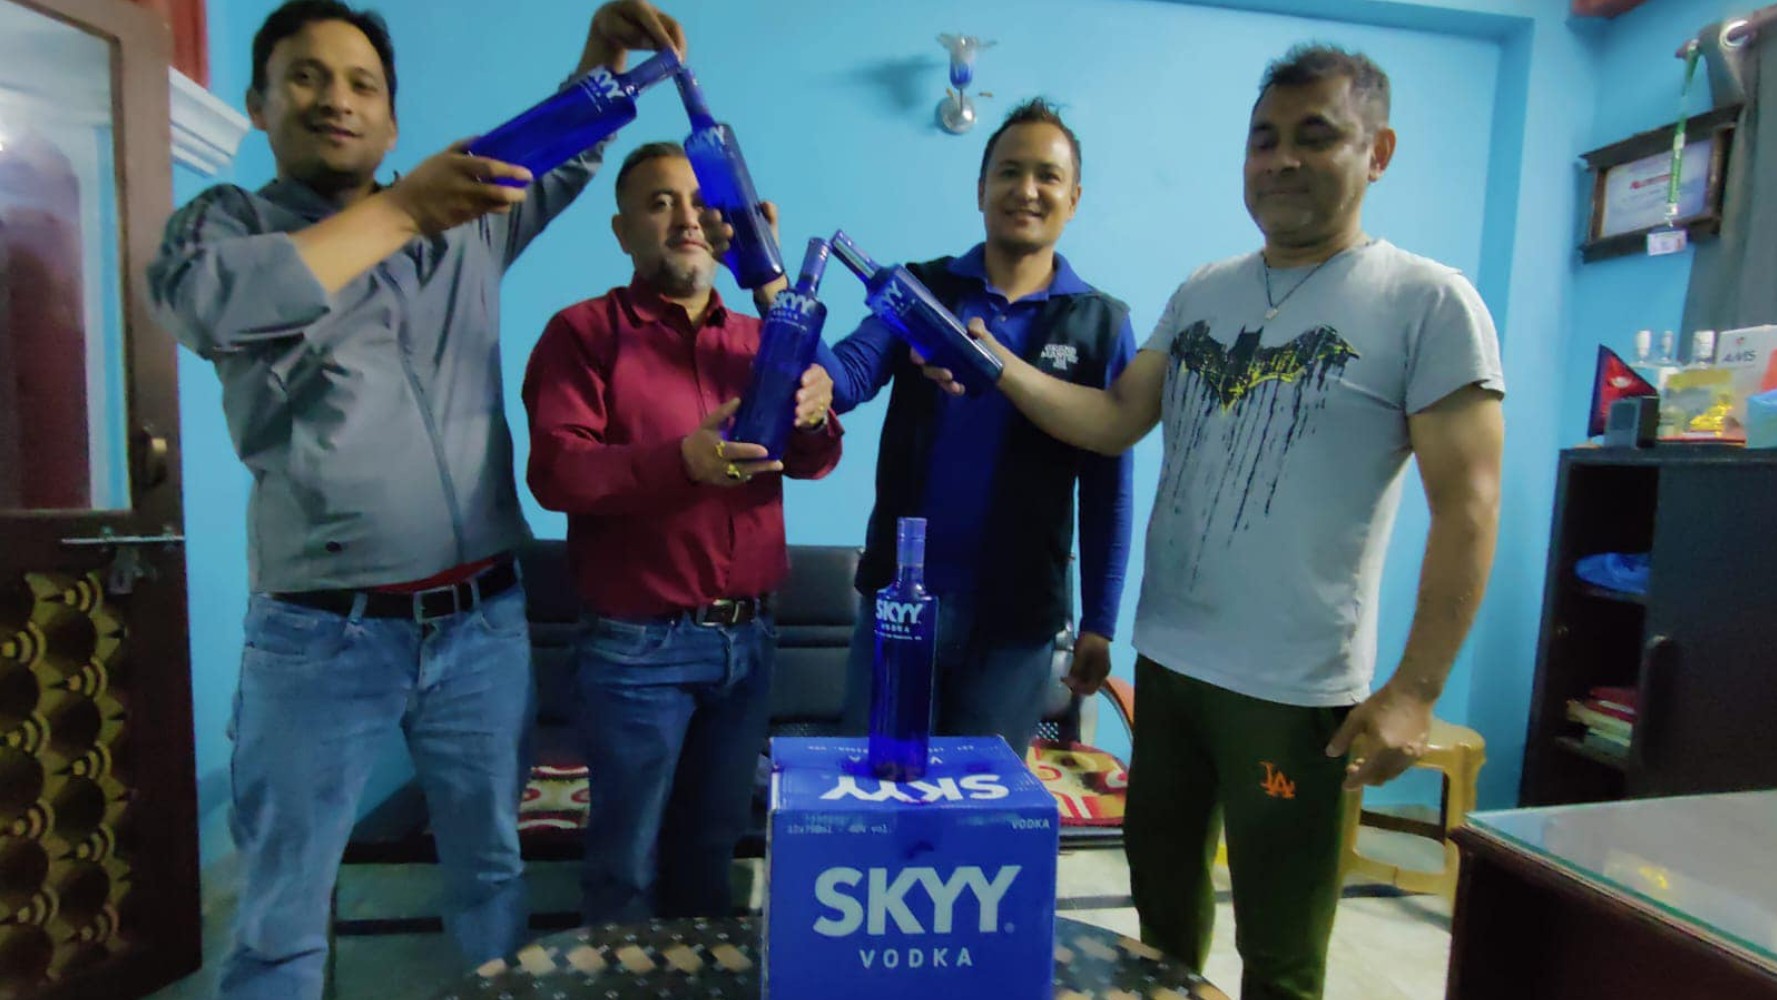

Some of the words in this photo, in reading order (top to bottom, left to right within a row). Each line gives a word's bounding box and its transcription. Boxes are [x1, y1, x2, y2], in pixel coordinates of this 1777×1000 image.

[876, 599, 923, 624] SKYY
[819, 774, 1010, 803] SKYY
[1260, 760, 1296, 799] LA
[1012, 818, 1050, 829] VODKA
[813, 865, 1022, 938] SKYY
[859, 947, 973, 969] VODKA
